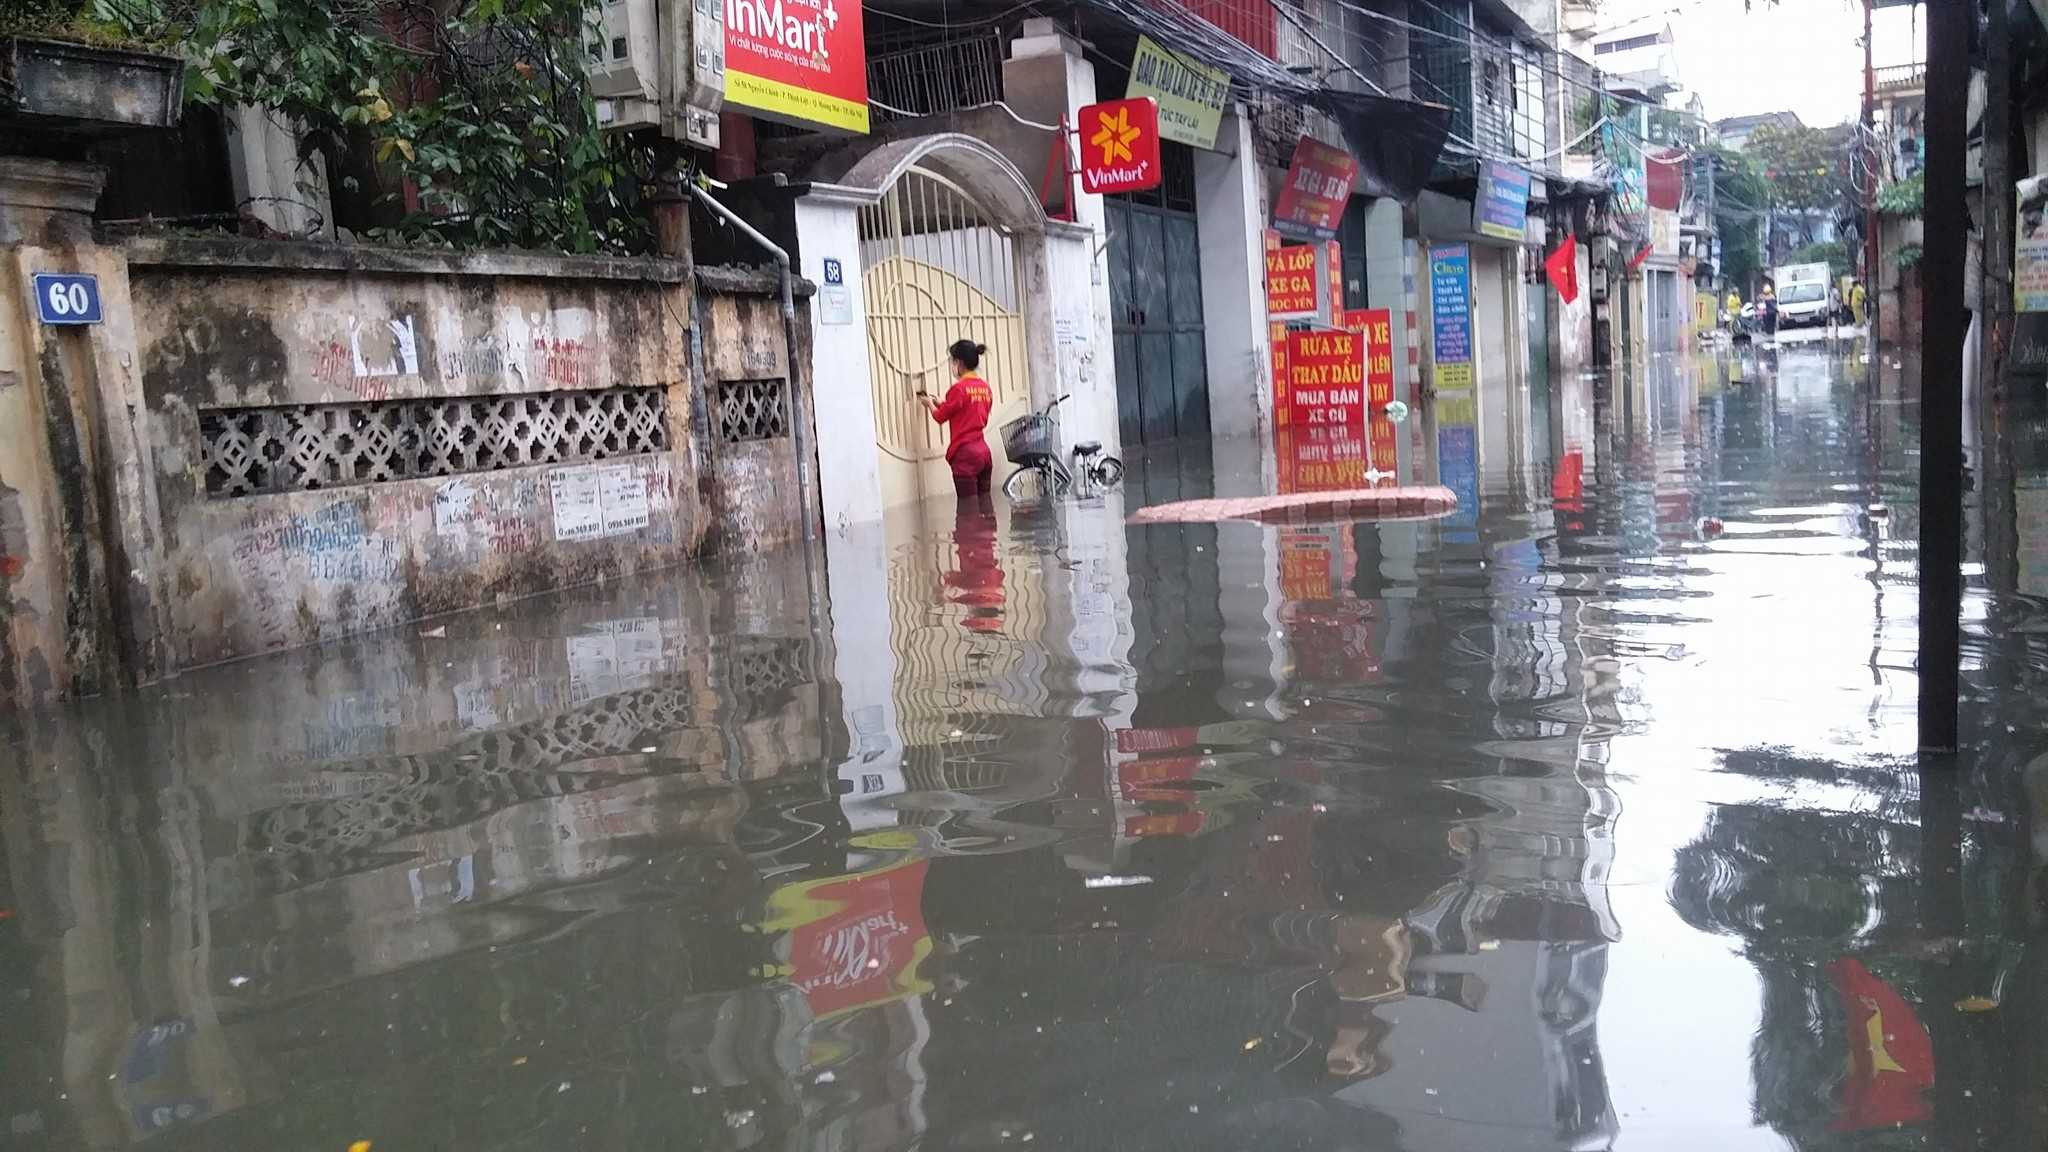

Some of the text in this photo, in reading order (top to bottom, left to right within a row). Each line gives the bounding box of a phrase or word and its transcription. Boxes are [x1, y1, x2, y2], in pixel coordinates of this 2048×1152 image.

[826, 261, 840, 281] 58
[1269, 275, 1312, 294] XE GA
[49, 282, 89, 315] 60
[1374, 322, 1389, 344] XE
[1334, 335, 1353, 355] XE
[1292, 364, 1329, 385] THAY
[1296, 386, 1360, 406] MUA BÁN
[1309, 408, 1326, 423] XE
